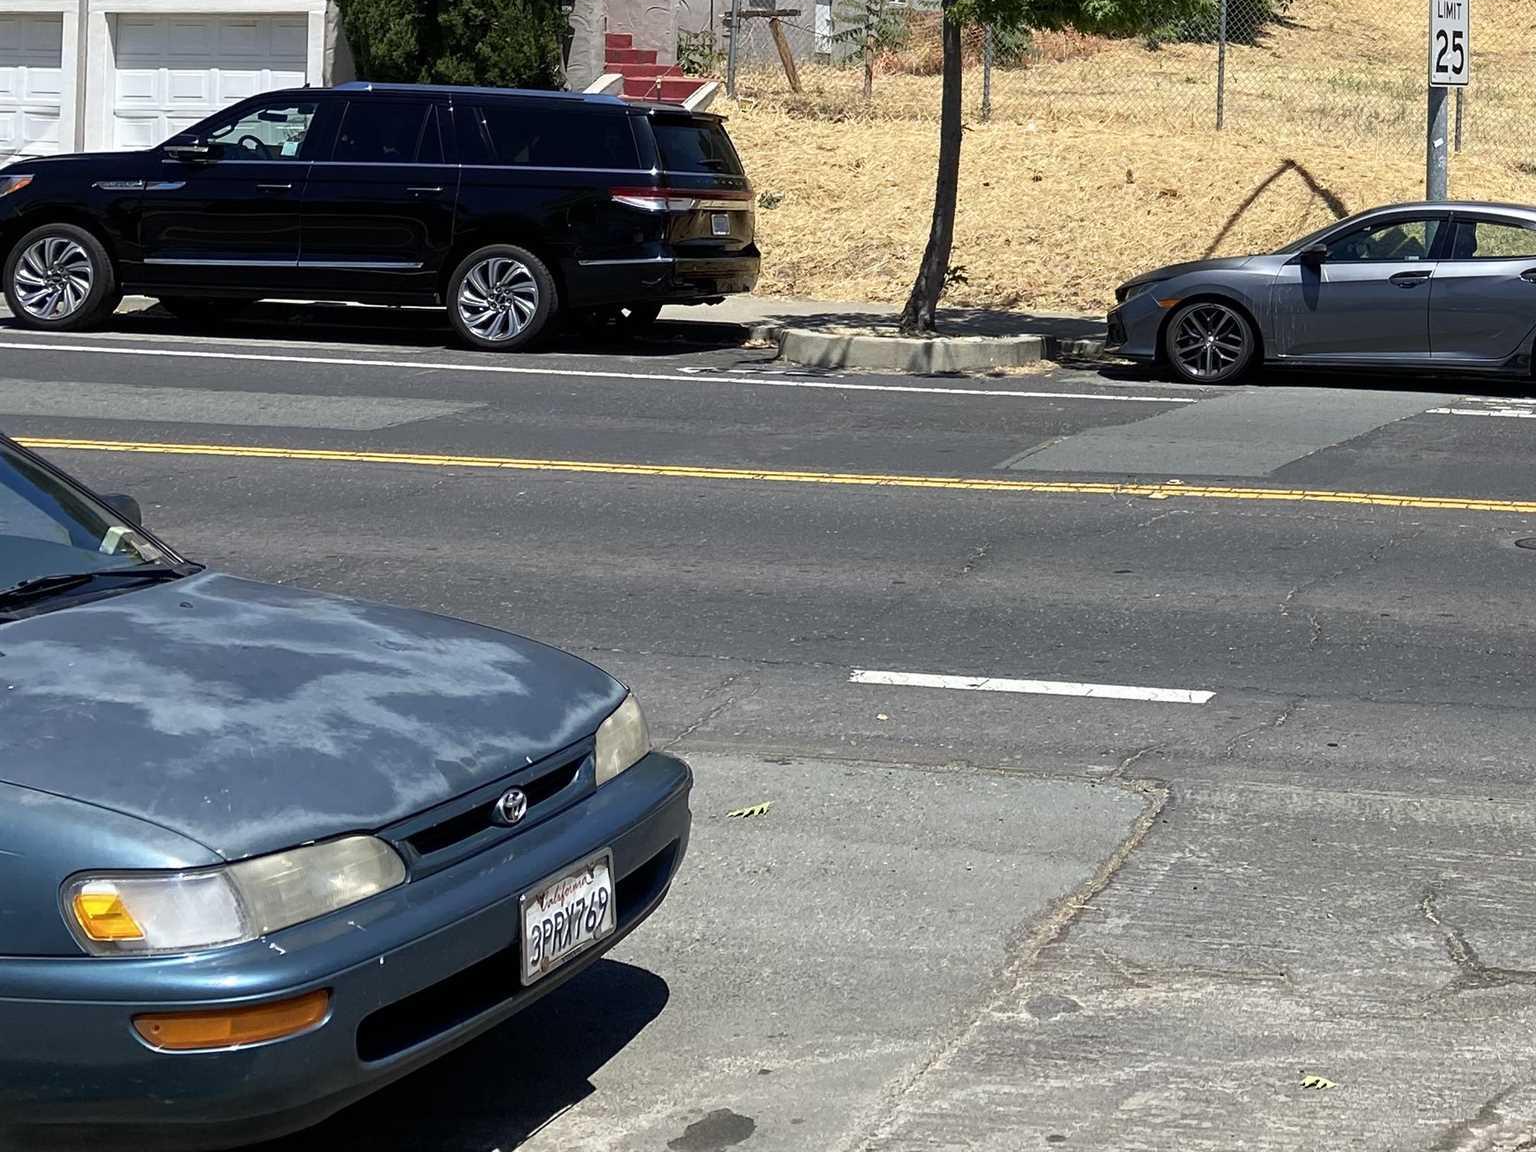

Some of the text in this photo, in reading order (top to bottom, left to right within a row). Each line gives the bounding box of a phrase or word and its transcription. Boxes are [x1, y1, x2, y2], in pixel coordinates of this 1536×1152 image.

[1437, 3, 1461, 20] LIMIT
[1435, 29, 1464, 75] 25
[530, 886, 608, 967] 3PRX769
